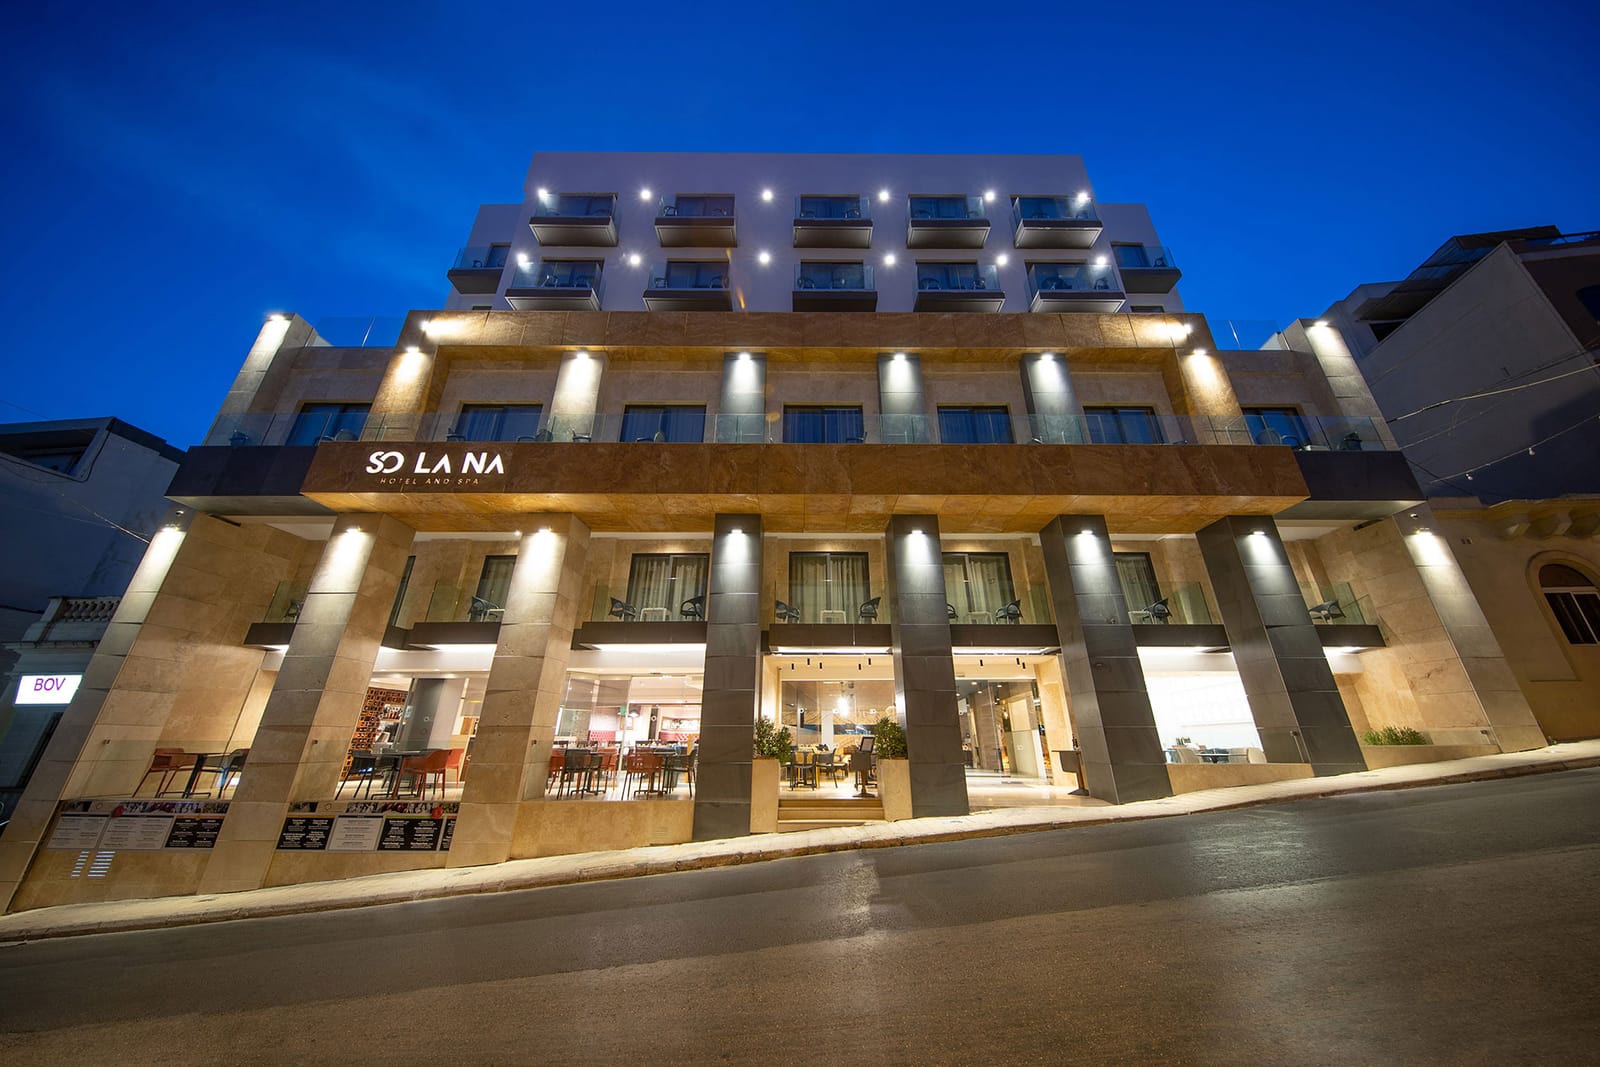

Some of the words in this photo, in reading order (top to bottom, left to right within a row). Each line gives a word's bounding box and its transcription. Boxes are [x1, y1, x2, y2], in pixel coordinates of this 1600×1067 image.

[365, 451, 405, 474] SO
[413, 451, 451, 474] LA
[461, 451, 505, 474] NA
[33, 677, 66, 691] BOV
